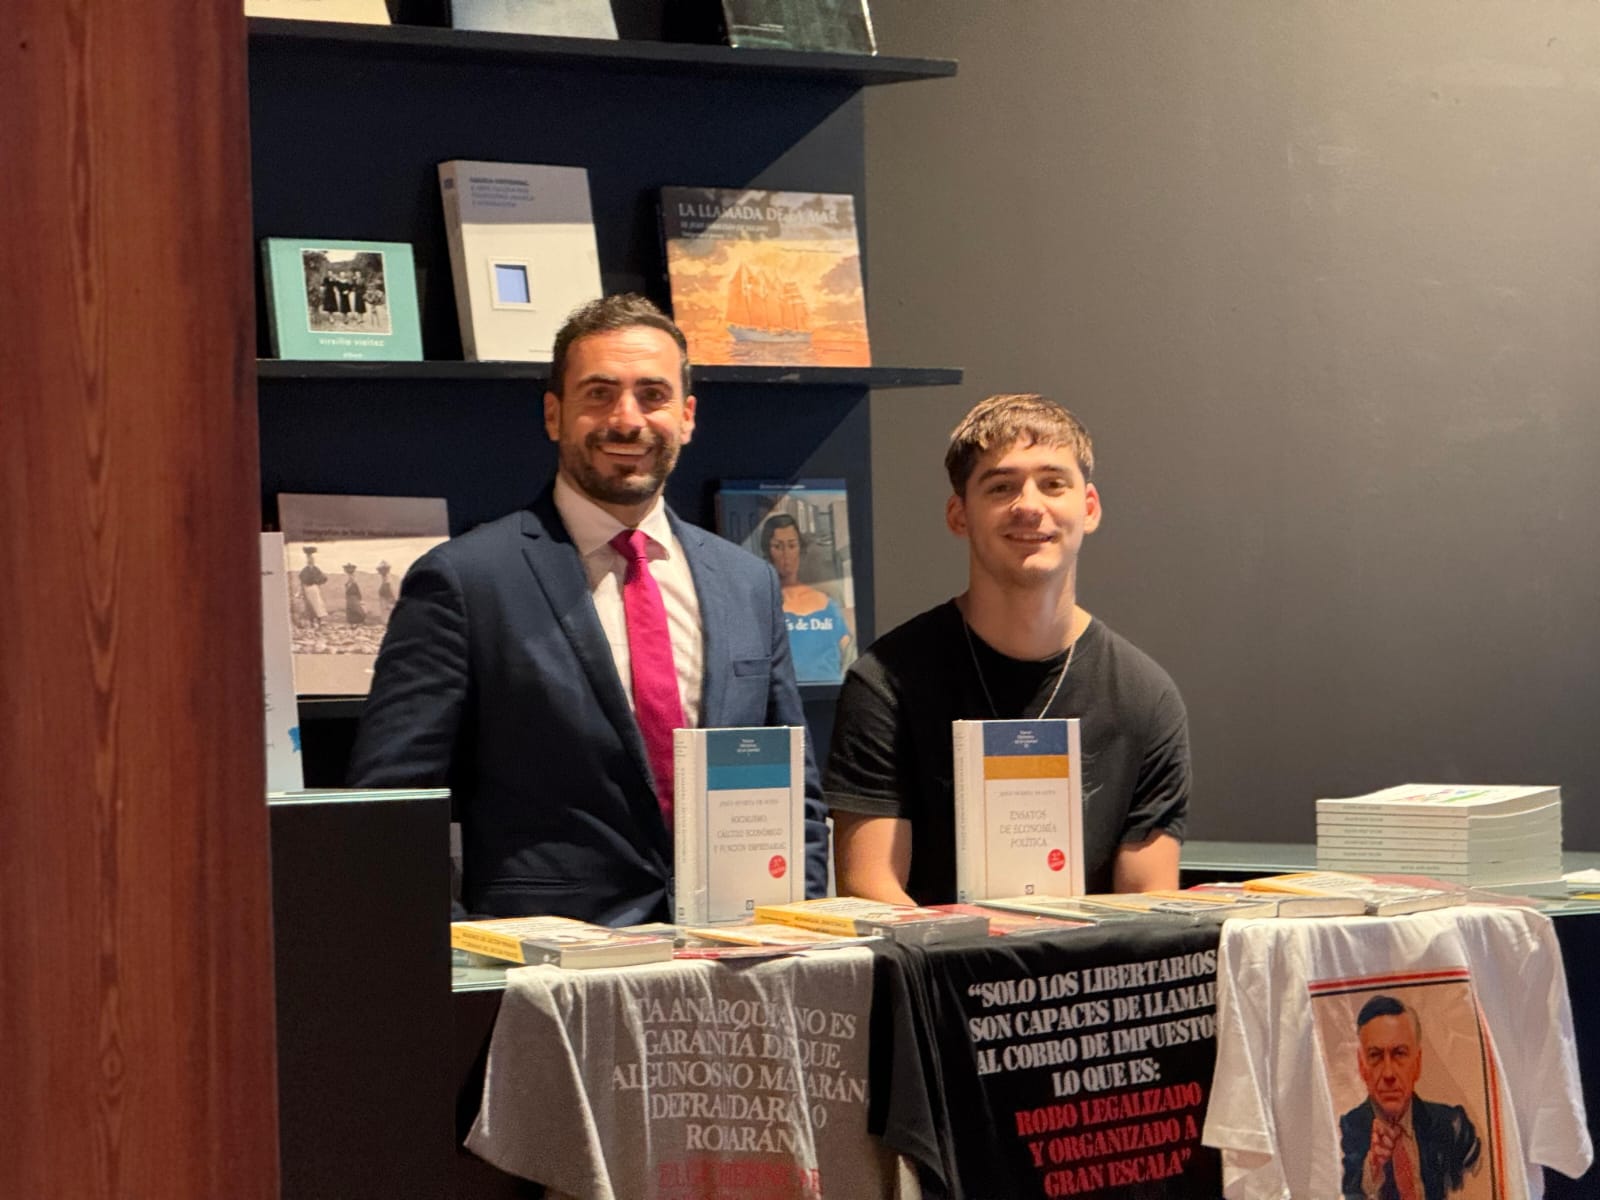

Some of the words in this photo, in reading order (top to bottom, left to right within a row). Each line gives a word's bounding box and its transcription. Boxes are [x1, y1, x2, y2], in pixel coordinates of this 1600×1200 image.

[679, 203, 695, 216] LA
[700, 203, 764, 221] LLAMADA
[795, 617, 809, 631] de
[1039, 970, 1079, 1000] LOS
[1082, 949, 1217, 994] LIBERTARIOS
[795, 1006, 826, 1035] NO
[829, 1011, 857, 1040] ES
[969, 1013, 1012, 1043] SON
[1014, 1001, 1110, 1037] CAPACES
[1114, 995, 1142, 1022] DE
[643, 1027, 757, 1058] GARANTÍA
[798, 1038, 841, 1069] QUE
[977, 1049, 1001, 1075] AL
[1002, 1037, 1078, 1071] COBRO
[1081, 1031, 1110, 1060] DE
[611, 1061, 721, 1090] ALGUNOS
[722, 1062, 754, 1089] NO
[757, 1065, 869, 1108] MAARÁN,
[1052, 1070, 1080, 1097] LO
[1083, 1063, 1127, 1092] QUE
[1130, 1057, 1162, 1084] ES:
[811, 1103, 828, 1129] O
[1015, 1103, 1078, 1137] ROBO
[1080, 1081, 1203, 1126] LEGALIZADO
[1028, 1141, 1044, 1168] Y
[1050, 1117, 1181, 1165] ORGANIZADO
[1185, 1114, 1198, 1140] A
[1043, 1164, 1104, 1199] GRAN
